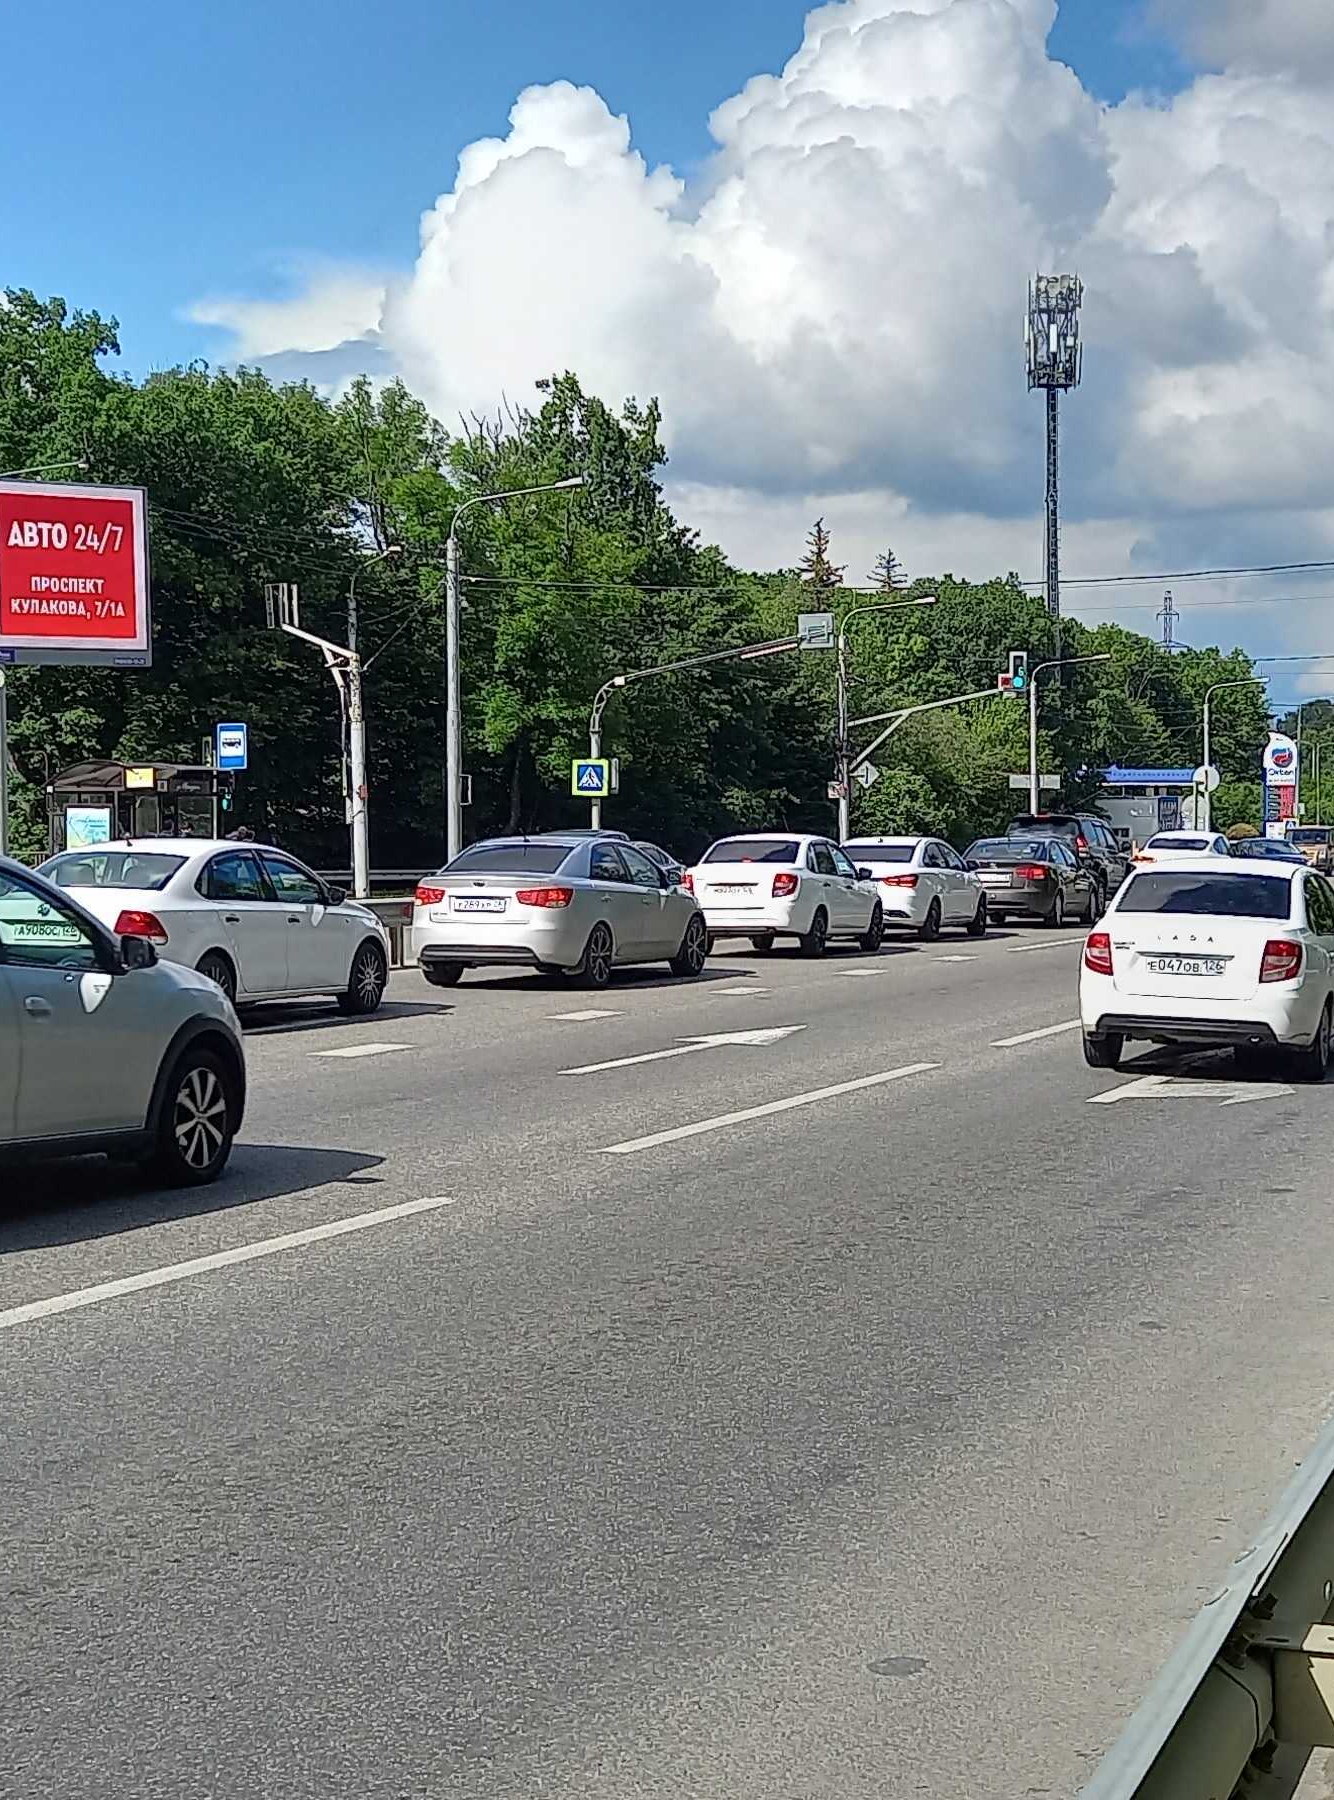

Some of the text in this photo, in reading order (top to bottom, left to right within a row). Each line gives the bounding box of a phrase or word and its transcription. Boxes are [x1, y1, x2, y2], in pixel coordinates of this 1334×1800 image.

[7, 520, 124, 554] АВТО 24/7
[31, 576, 104, 594] ПРОСПЕКТ
[11, 599, 91, 620] КУЛАКОВА,
